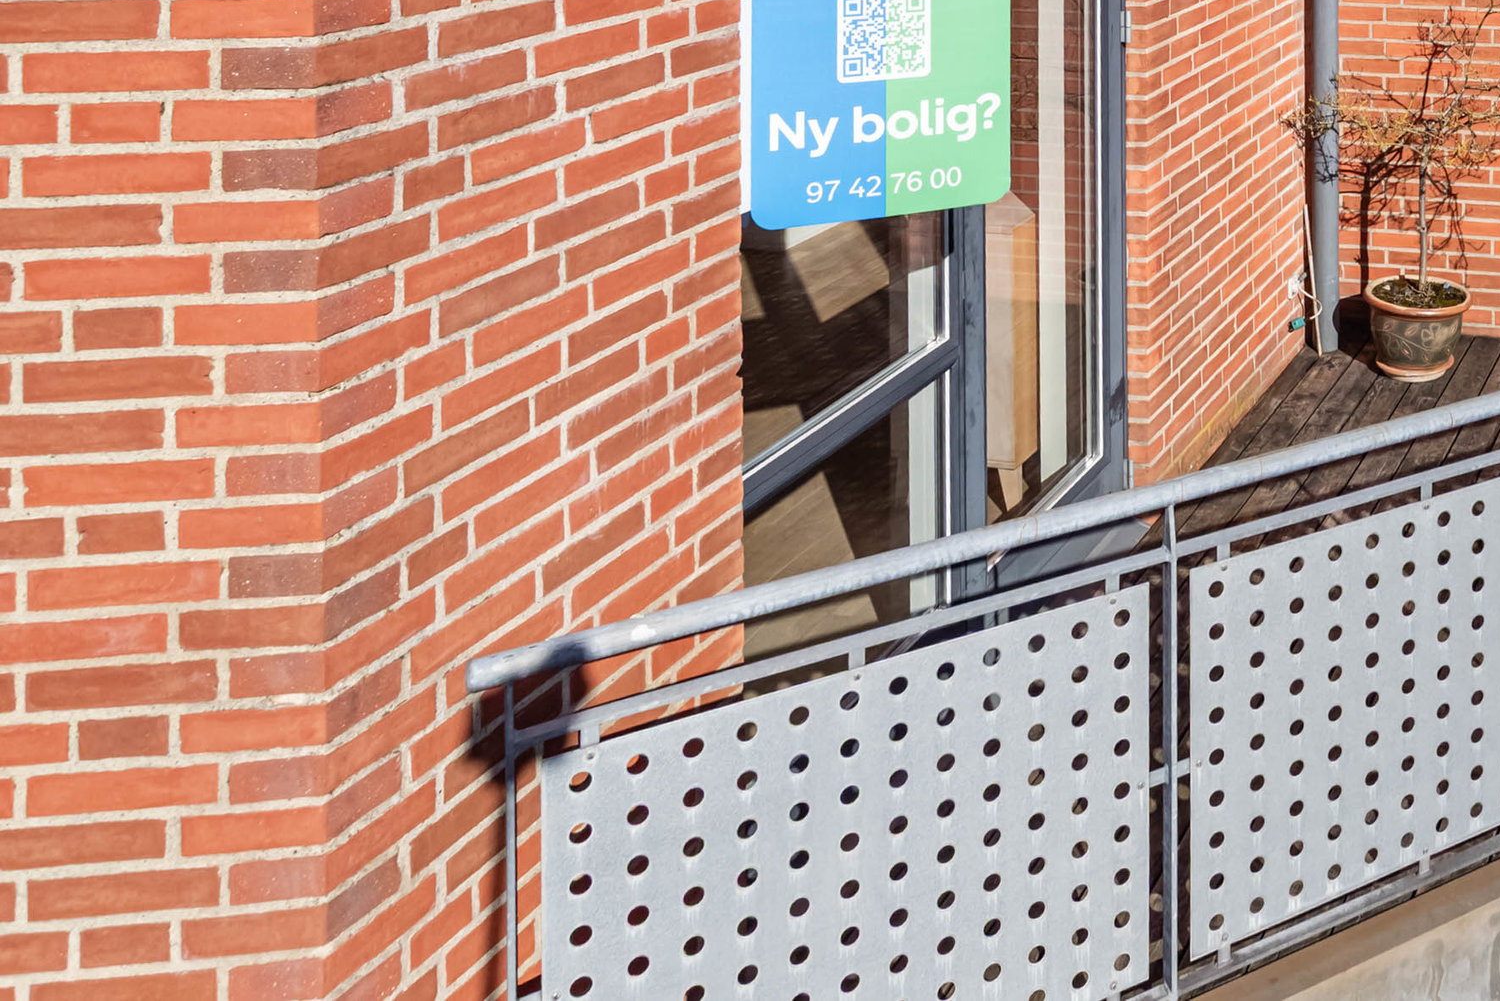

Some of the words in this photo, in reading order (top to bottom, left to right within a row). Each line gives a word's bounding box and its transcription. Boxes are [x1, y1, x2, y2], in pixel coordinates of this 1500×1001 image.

[768, 110, 839, 158] Ny
[852, 92, 1001, 143] bolig?
[806, 180, 841, 204] 97
[848, 175, 883, 198] 42
[890, 171, 923, 194] 76
[930, 166, 963, 189] 00
